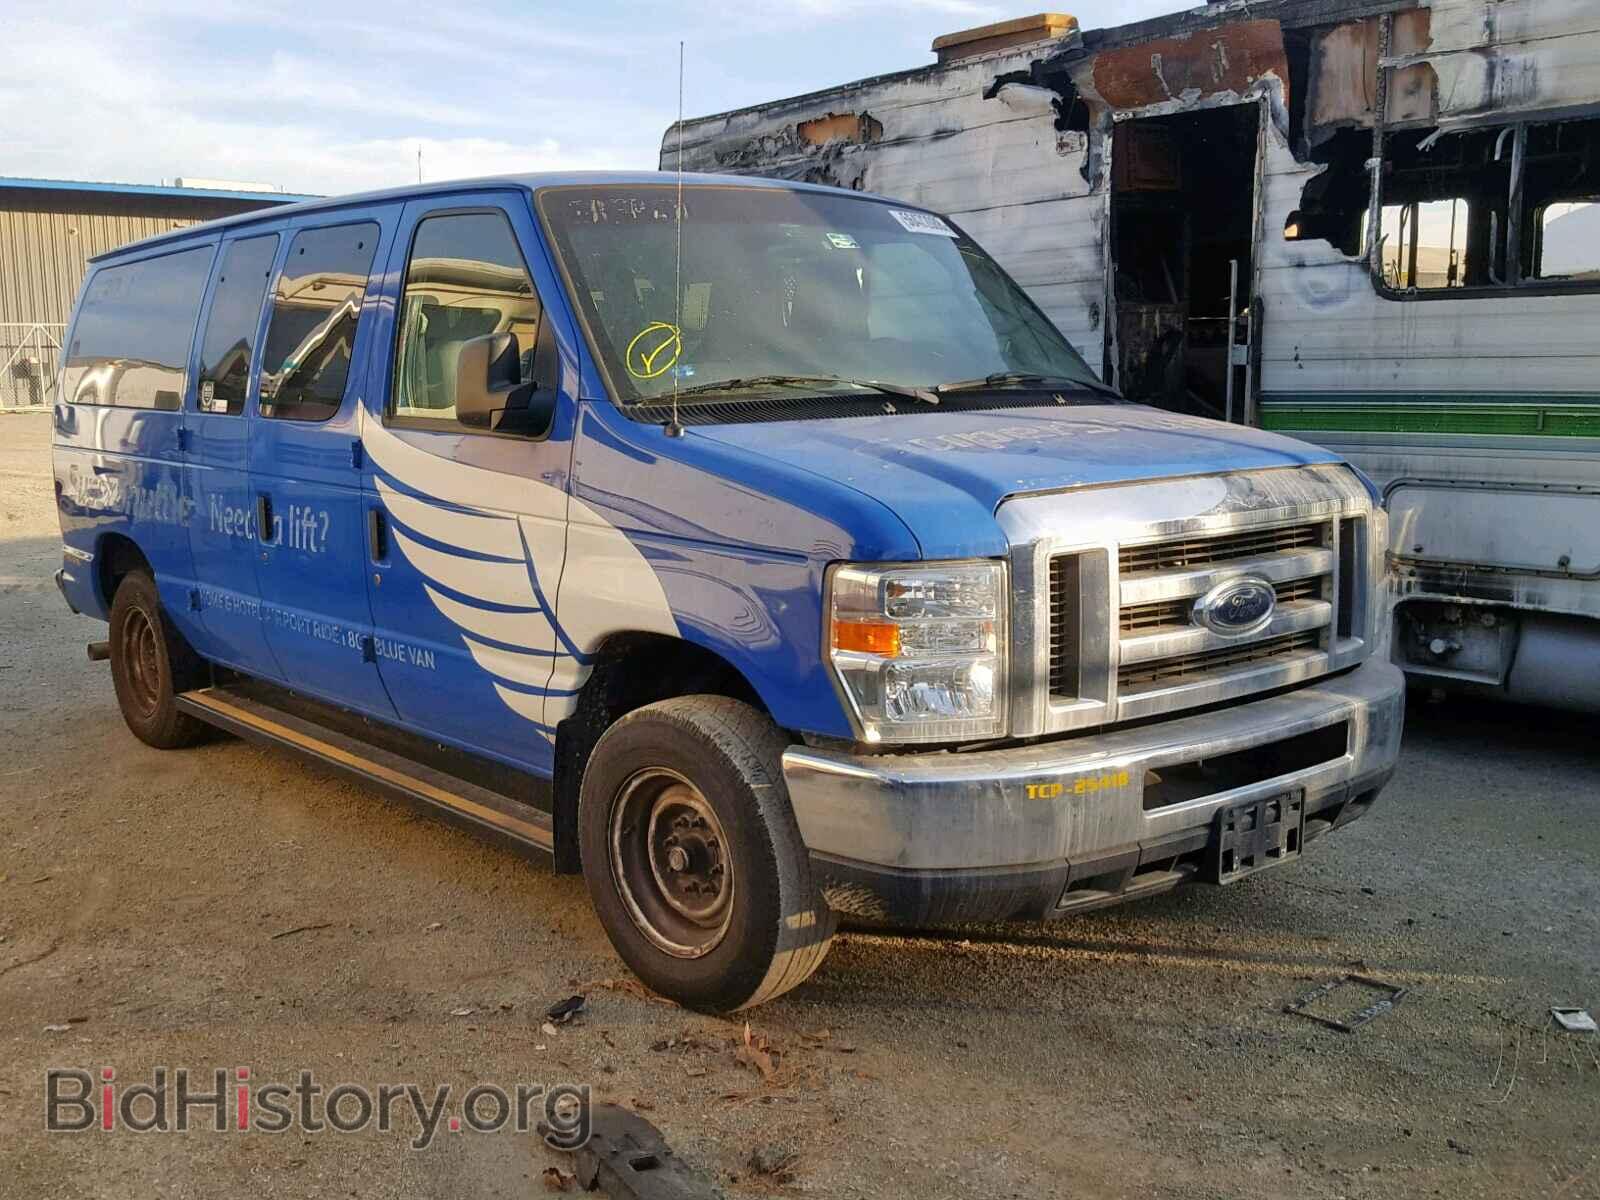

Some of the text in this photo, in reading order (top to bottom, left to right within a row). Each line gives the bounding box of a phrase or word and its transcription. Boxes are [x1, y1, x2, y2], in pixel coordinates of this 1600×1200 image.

[289, 504, 329, 552] lift?
[374, 637, 406, 662] BLUE
[407, 645, 436, 670] VAN
